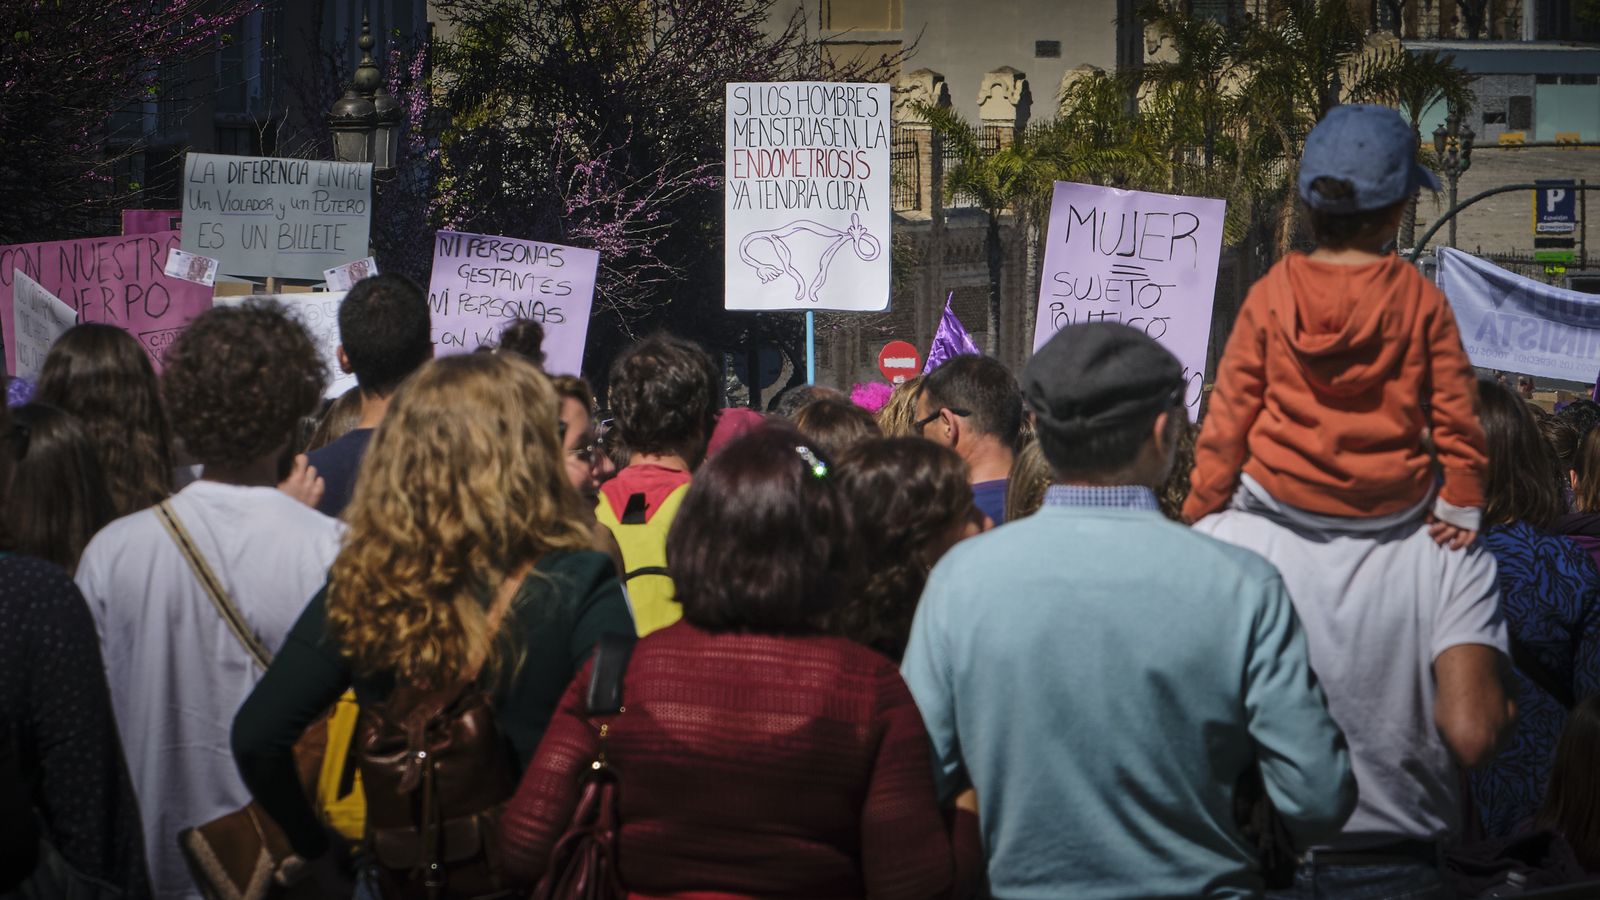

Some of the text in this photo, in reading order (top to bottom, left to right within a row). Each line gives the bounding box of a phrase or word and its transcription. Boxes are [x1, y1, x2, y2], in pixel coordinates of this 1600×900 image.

[733, 85, 880, 118] SI LOS HOMBRES
[733, 117, 888, 150] MENSTRUASEN, LA
[189, 154, 366, 191] LA DIFERENCIA ENTRE
[733, 148, 871, 180] ENDOMETRIOSIS
[730, 180, 752, 210] YA
[826, 180, 870, 212] CURA
[198, 222, 348, 251] ES UN BILLETE
[439, 234, 565, 268] NI PERSONAS
[1065, 203, 1200, 272] MUJER
[1, 245, 42, 287] CON
[457, 264, 572, 296] GESTANTES
[428, 288, 566, 324] NI PERSONAS
[1052, 271, 1177, 309] SUJETO
